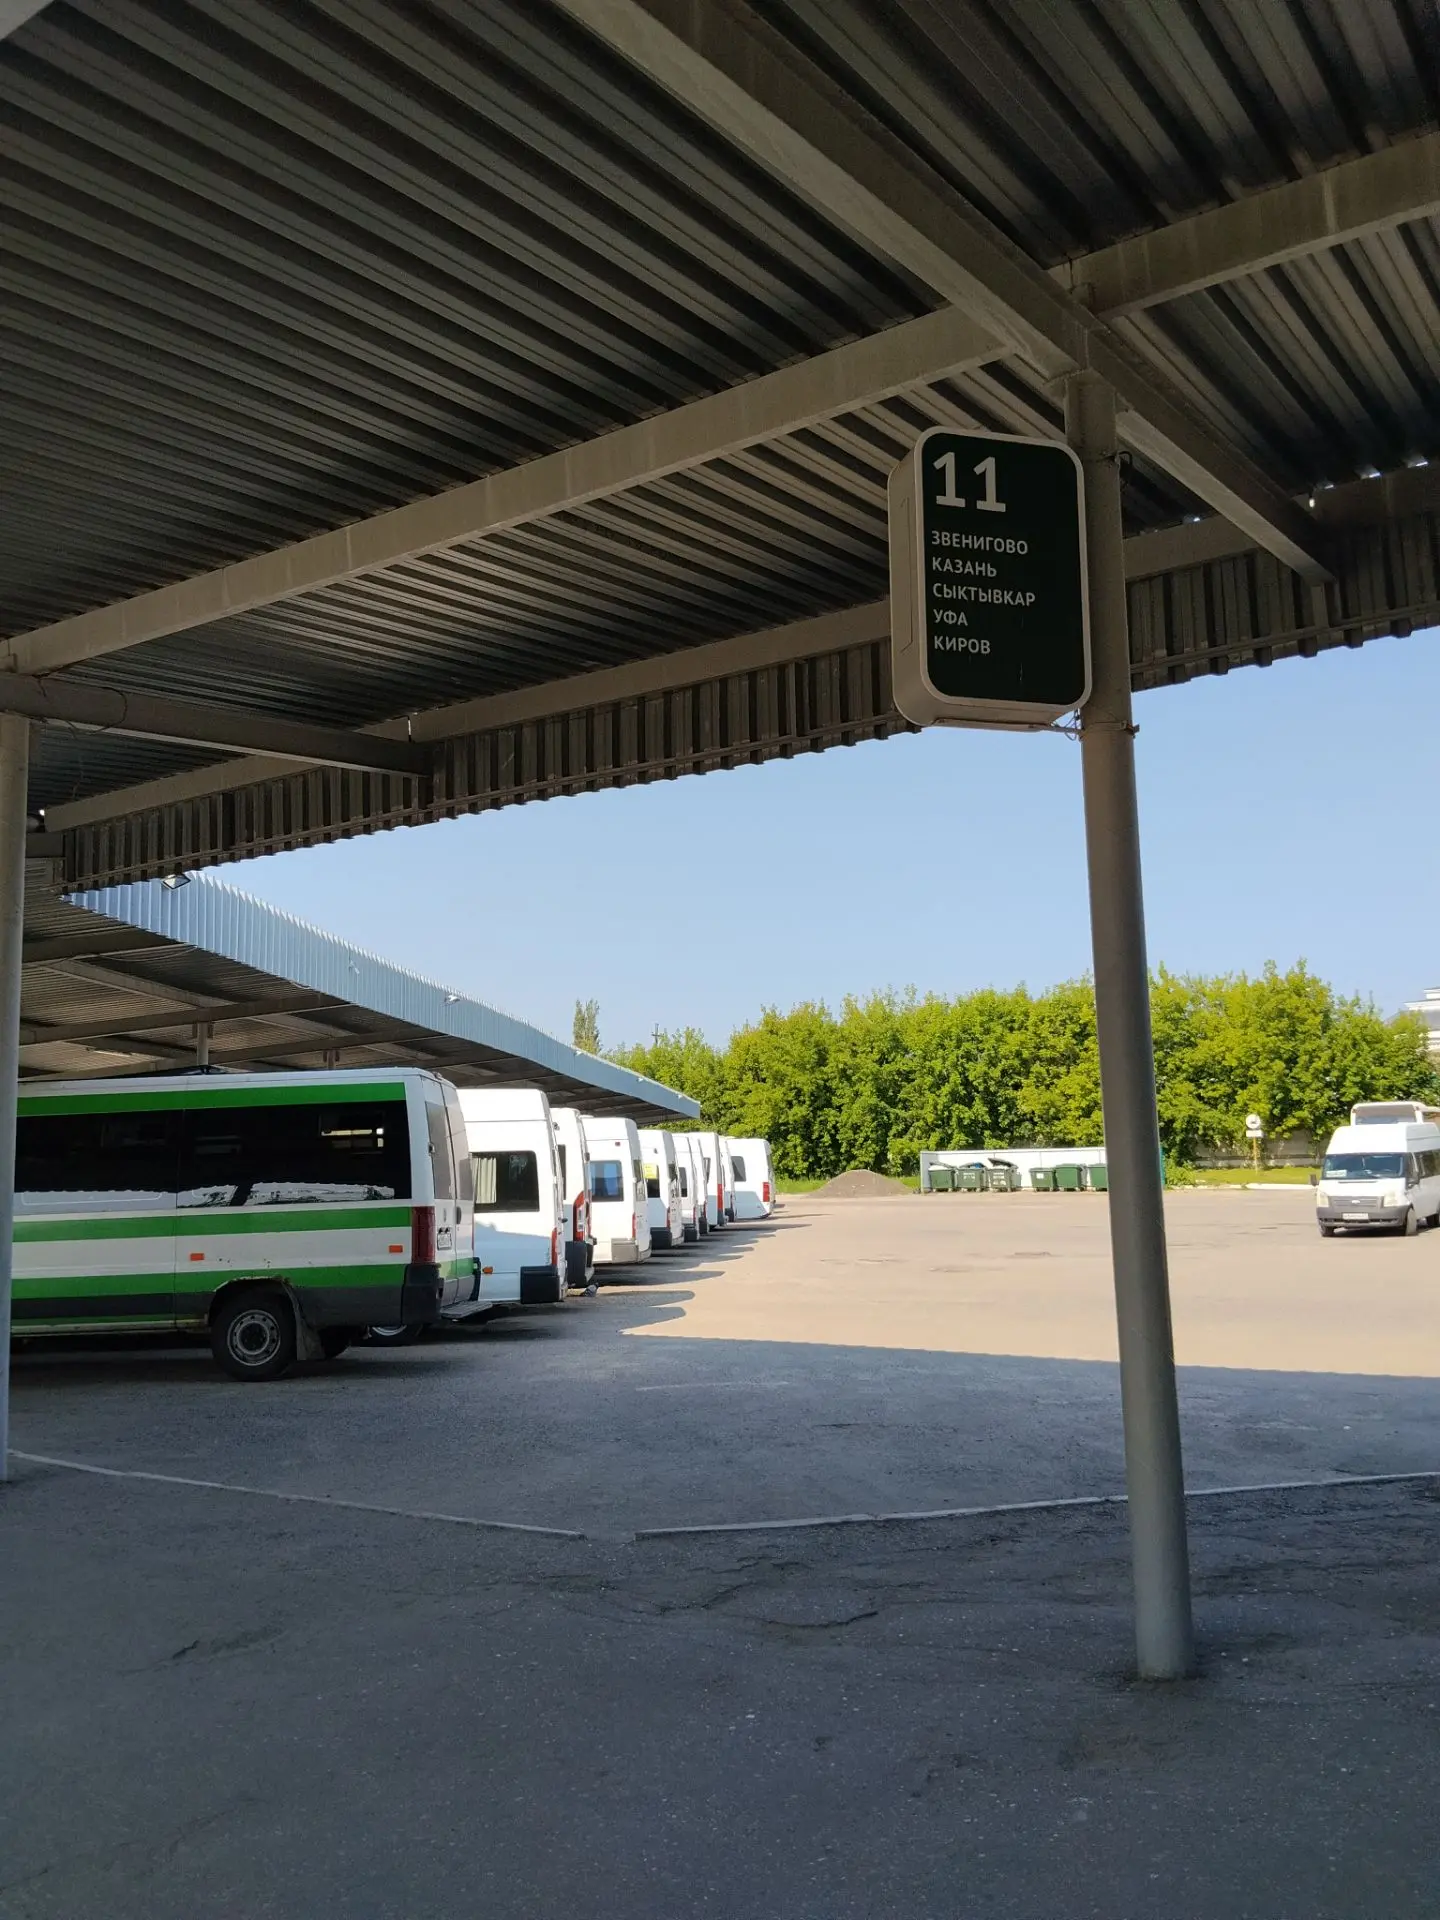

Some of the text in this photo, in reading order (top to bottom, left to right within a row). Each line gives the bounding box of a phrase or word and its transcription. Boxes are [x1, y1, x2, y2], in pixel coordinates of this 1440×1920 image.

[933, 452, 1006, 512] 11
[931, 530, 1028, 555] ЗВЕНИГОВО
[932, 556, 997, 578] КАЗАНЬ
[932, 582, 1036, 607] СЫКТЫВКАР
[933, 608, 969, 627] УФА
[934, 635, 991, 655] КИРОВ
